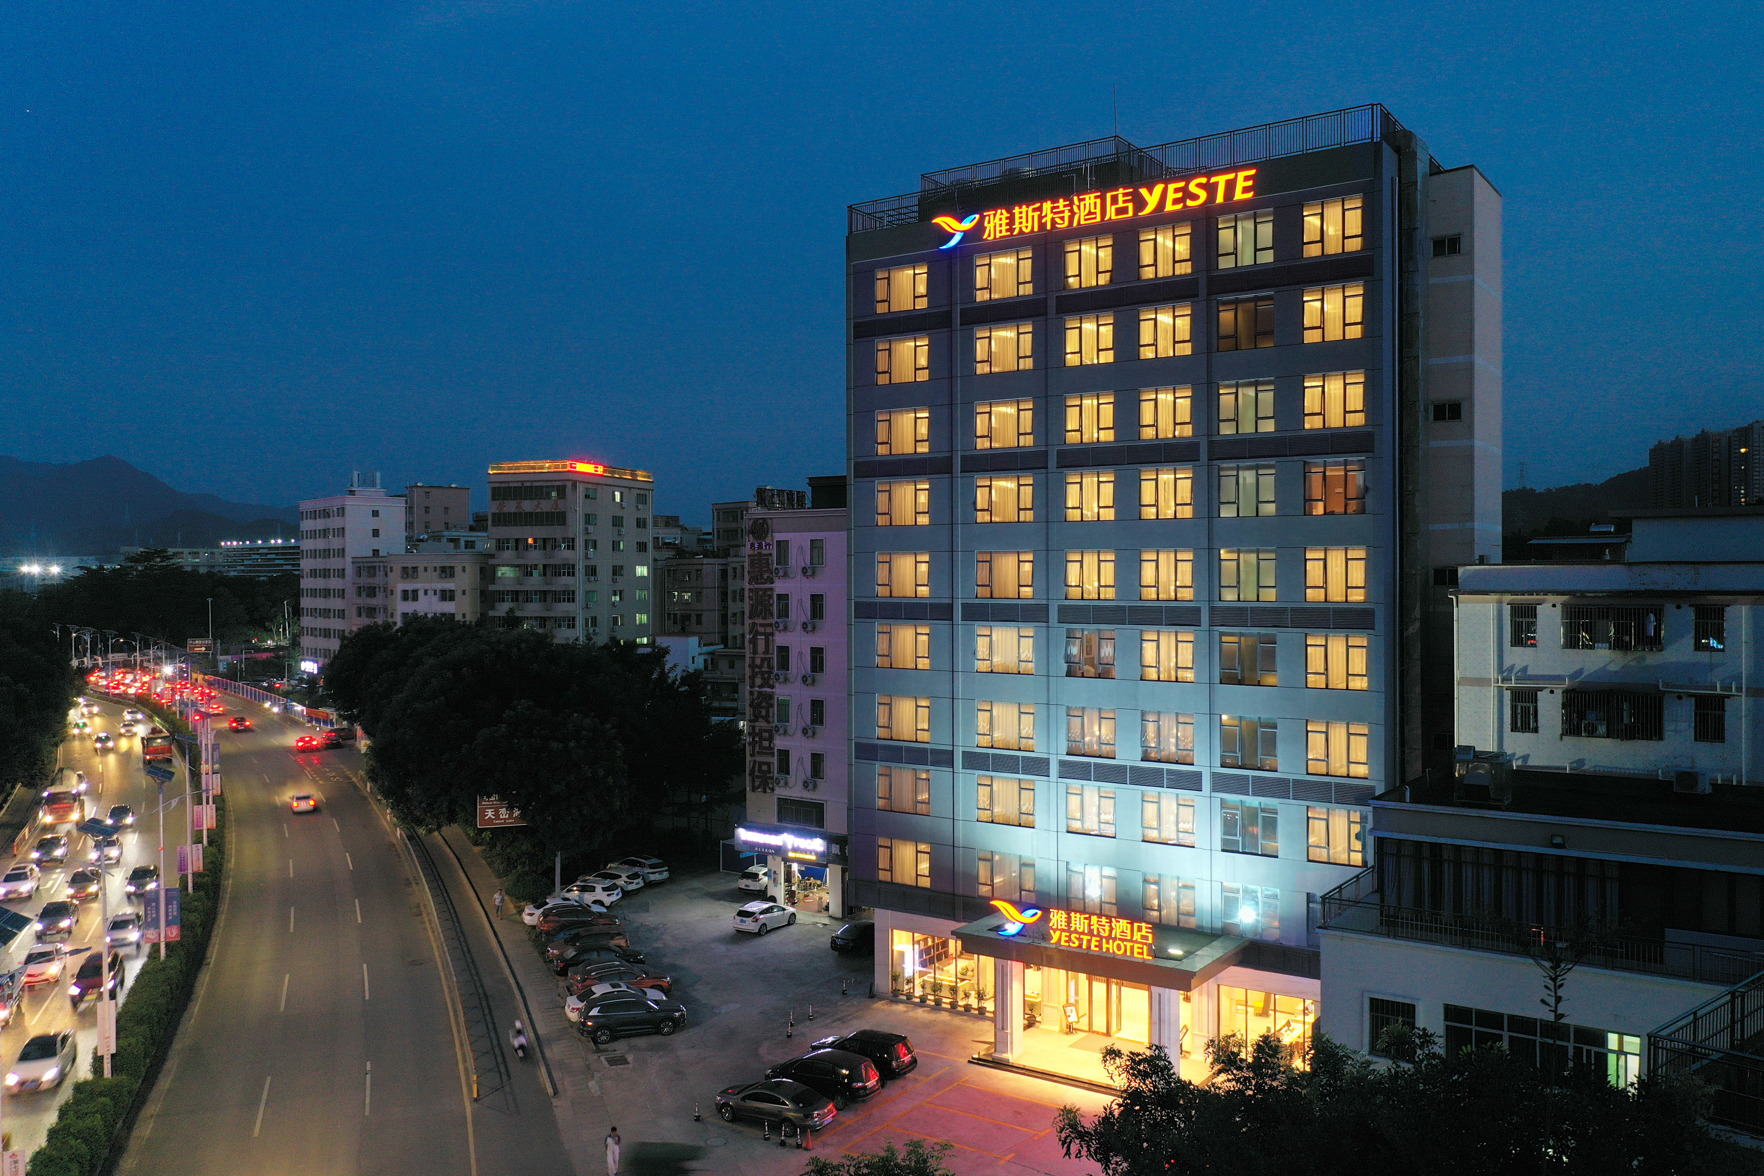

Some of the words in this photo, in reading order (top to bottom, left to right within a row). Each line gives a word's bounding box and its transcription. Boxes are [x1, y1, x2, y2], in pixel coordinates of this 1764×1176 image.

[983, 187, 1134, 240] 雅斯特酒店
[1138, 169, 1257, 216] YESTE
[747, 551, 775, 793] 惠源行投资担保
[1050, 909, 1153, 944] 雅斯特酒店
[1050, 930, 1100, 951] YESTE
[1102, 938, 1153, 960] HOTEL
